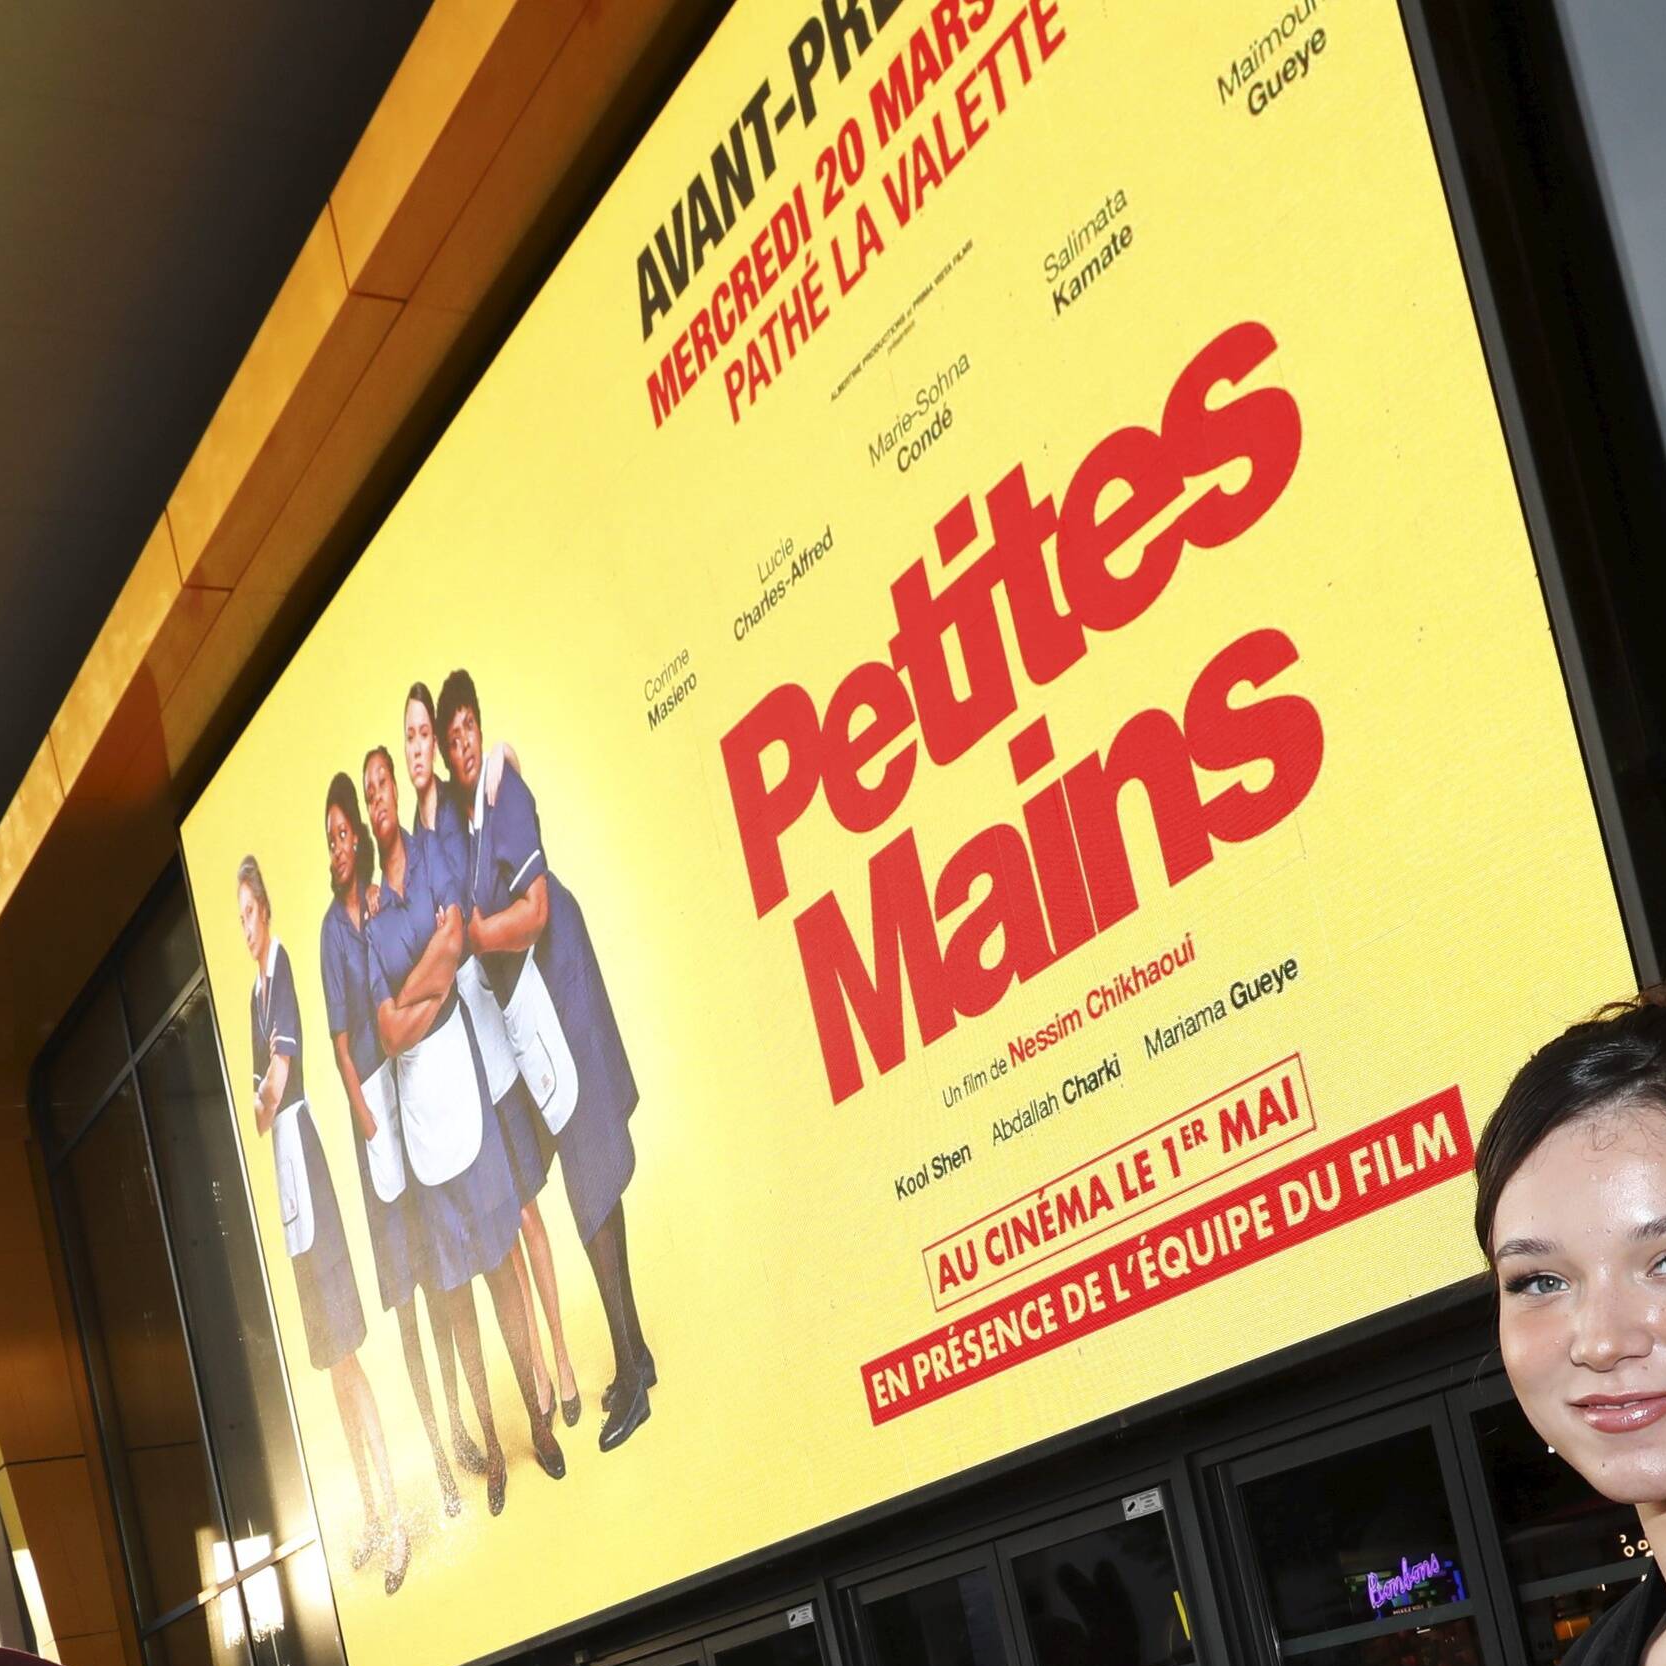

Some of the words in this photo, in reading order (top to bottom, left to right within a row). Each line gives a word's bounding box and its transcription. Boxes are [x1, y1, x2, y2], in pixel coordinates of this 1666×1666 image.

[1247, 27, 1326, 116] Gueye
[637, 0, 903, 343] AVANT-PR
[724, 250, 830, 425] PATHÉ
[831, 201, 885, 297] LA
[882, 0, 1066, 229] VALETTE
[646, 181, 812, 429] MERCREDI
[816, 117, 865, 219] 20
[1044, 189, 1127, 283] Salimata
[1052, 224, 1133, 316] Kamate
[867, 353, 971, 467] Marie-Sohna
[897, 402, 953, 473] Condé
[733, 524, 833, 642] Charles-Alfred
[757, 537, 794, 584] Lucie
[719, 321, 1302, 920] Petites
[644, 648, 690, 702] Corinne
[647, 672, 697, 731] Masiero
[793, 627, 1323, 1106] Mains
[942, 1085, 962, 1108] Un
[963, 1069, 987, 1096] film
[989, 1057, 1007, 1081] de
[1007, 1008, 1083, 1068] Nessim
[1086, 932, 1195, 1020] Chikhaoui
[1144, 996, 1226, 1060] Mariama
[1229, 957, 1299, 1010] Gueye
[992, 1092, 1060, 1146] Abdallah
[1062, 1053, 1121, 1104] Charki
[894, 1165, 929, 1200] Kool
[931, 1144, 972, 1177] Shen
[939, 1239, 978, 1294] AU
[984, 1174, 1114, 1266] CINÉMA
[1116, 1149, 1156, 1202] LE
[1219, 1076, 1299, 1154] MAI
[871, 1362, 911, 1408] EN
[912, 1294, 1058, 1390] PRÉSENCE
[1060, 1271, 1107, 1324] DE
[1108, 1194, 1274, 1303] L'ÉQUIPE
[1278, 1161, 1341, 1228] DU
[1349, 1111, 1458, 1197] FILM
[1366, 1552, 1441, 1609] Bonbons
